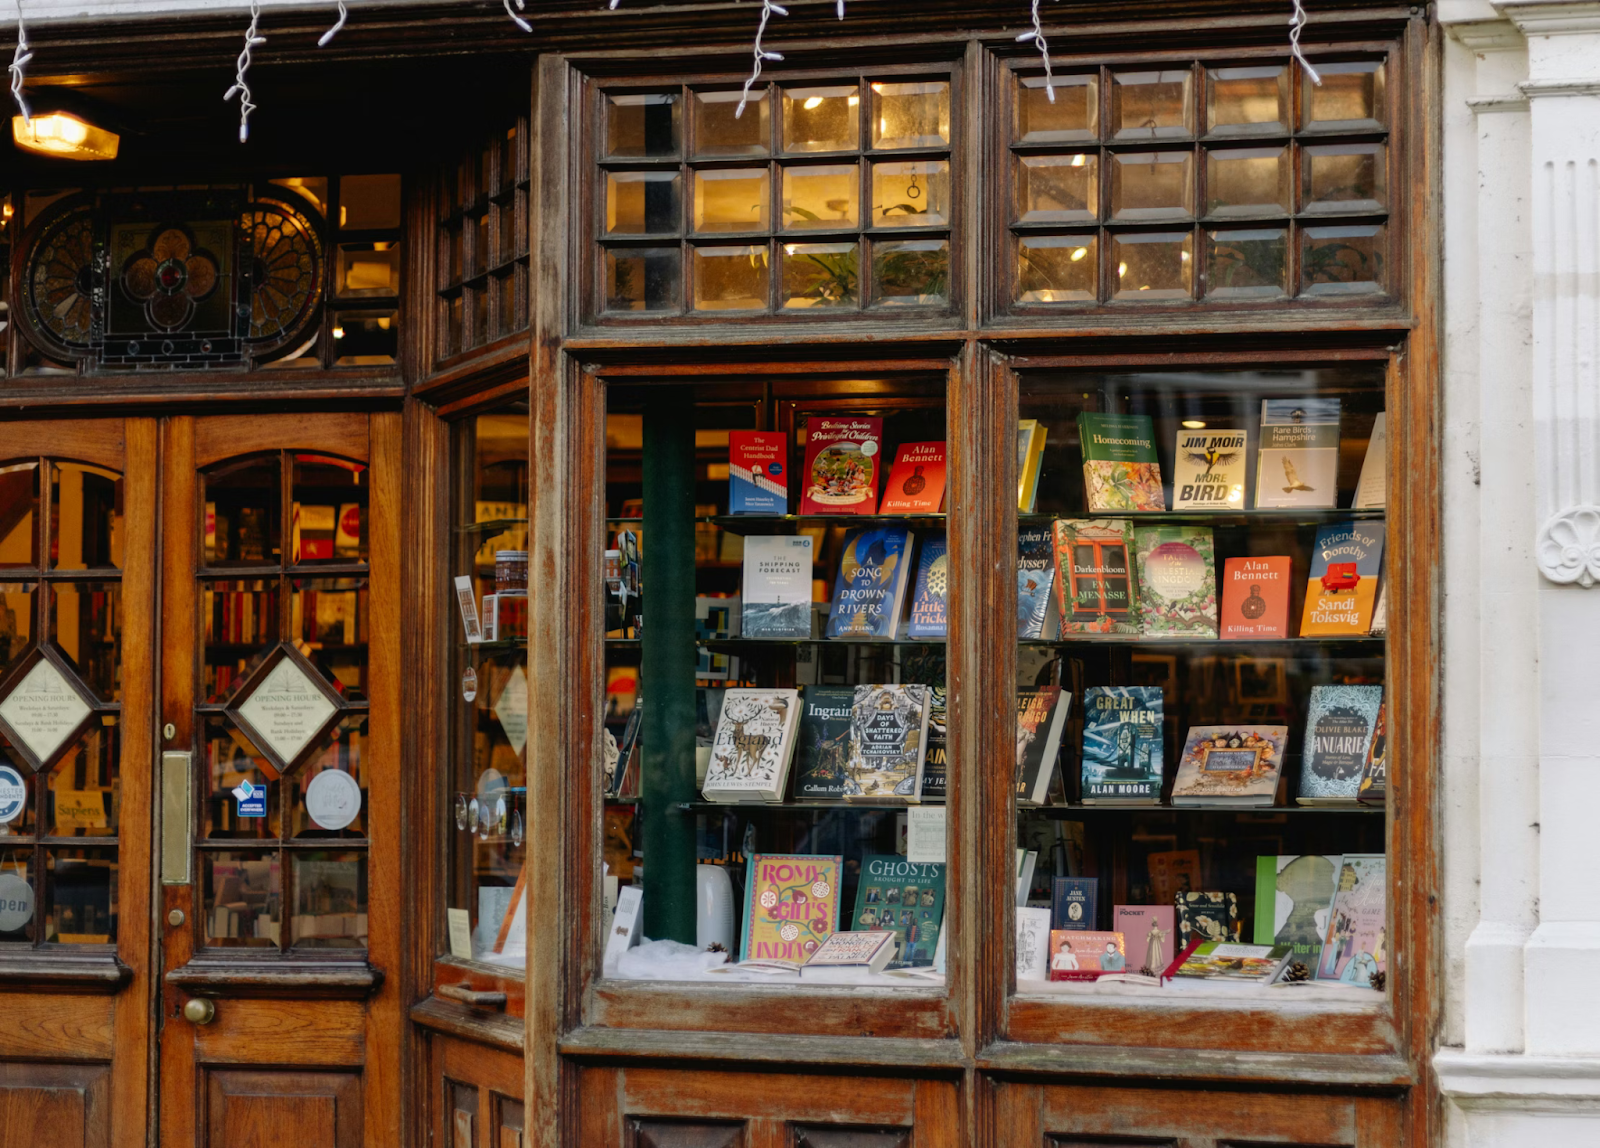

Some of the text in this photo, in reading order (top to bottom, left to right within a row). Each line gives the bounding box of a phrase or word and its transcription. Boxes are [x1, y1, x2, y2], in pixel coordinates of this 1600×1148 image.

[821, 421, 870, 429] Bedtime Stories
[811, 431, 878, 441] Privileged Children
[1093, 434, 1151, 449] Homecoming
[1182, 437, 1244, 448] JIM MOIR
[912, 446, 936, 454] Alan
[902, 454, 942, 462] Bennett
[1195, 474, 1228, 483] MORE
[1179, 484, 1242, 502] BIRDS
[1320, 530, 1375, 549] Friends of
[1322, 546, 1366, 561] Dorothy
[867, 557, 873, 565] A
[1244, 561, 1269, 570] Alan
[851, 568, 882, 578] SONG
[1234, 571, 1278, 580] Bennett
[841, 589, 886, 601] DROWN
[920, 591, 929, 601] A
[1079, 591, 1126, 599] MENASSE
[838, 604, 882, 616] RIVERS
[913, 602, 944, 612] Little
[1318, 598, 1354, 610] Sandi
[1310, 611, 1359, 625] Toksvig
[1096, 697, 1135, 710] GREAT
[1120, 711, 1154, 723] WHEN
[716, 732, 783, 746] England
[1091, 785, 1150, 793] ALAN MOORE
[58, 804, 99, 818] Sapiens
[763, 864, 823, 885] ROMY
[869, 860, 939, 878] GHOSTS
[757, 942, 803, 959] INDIA
